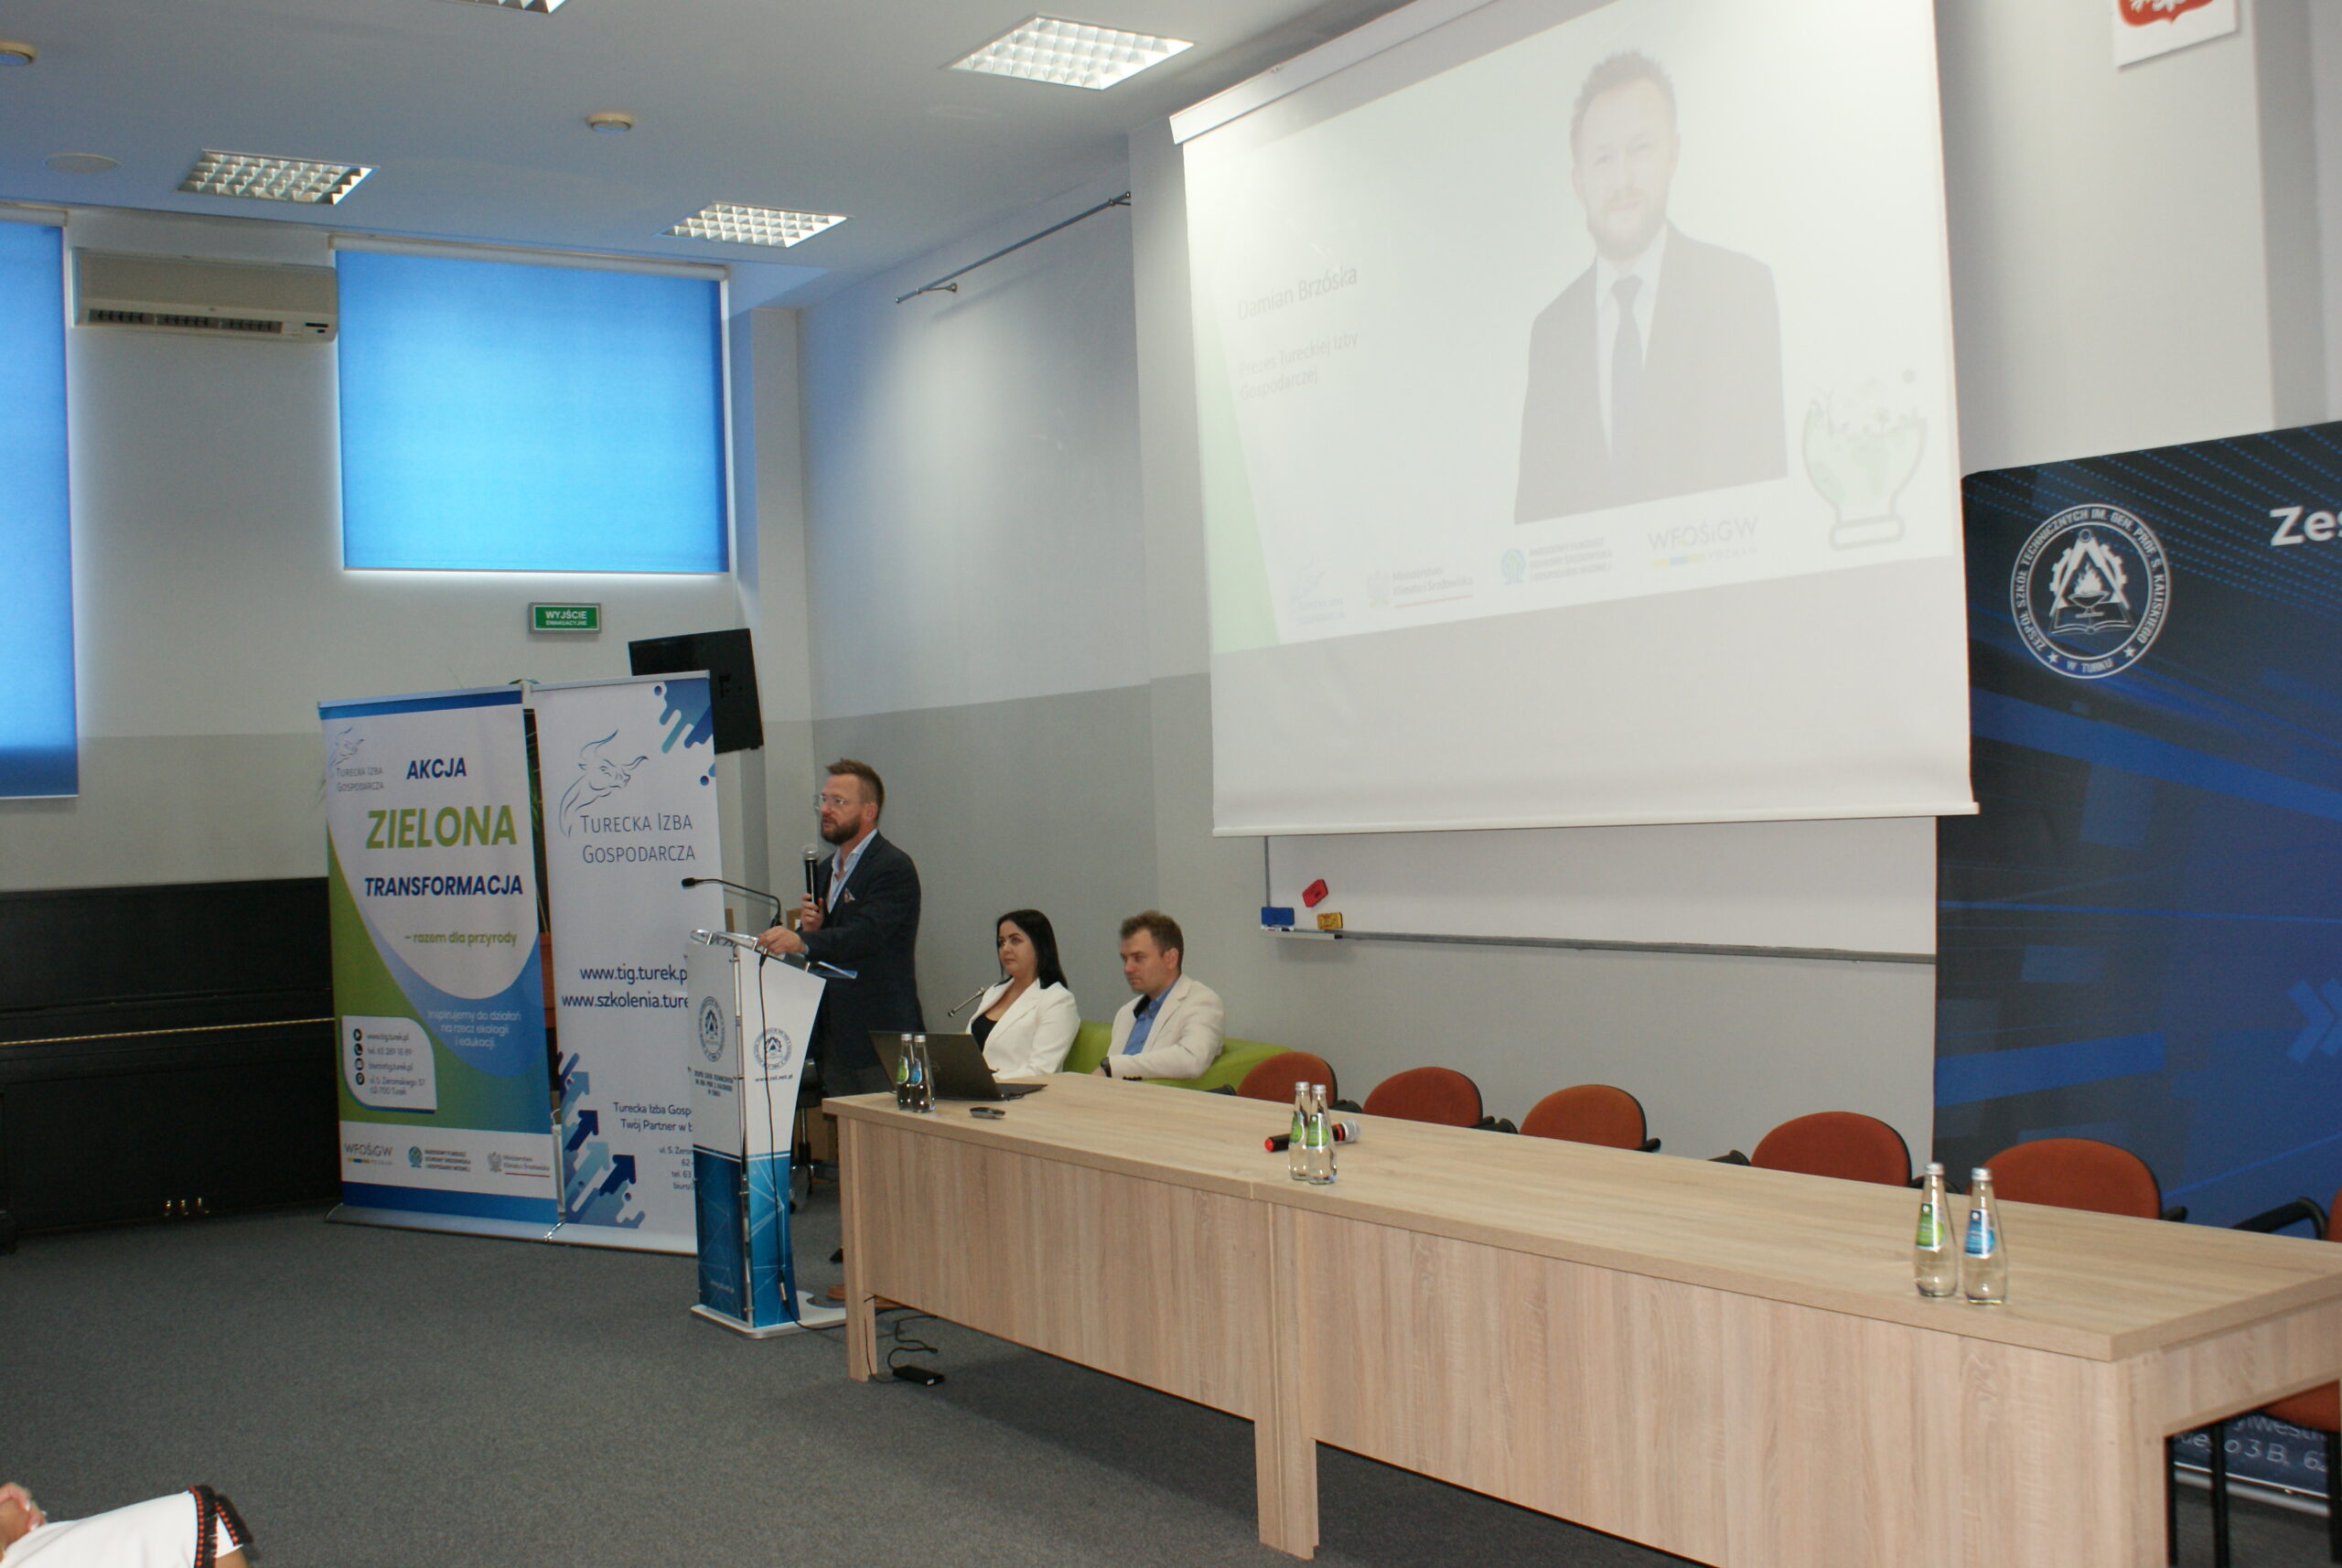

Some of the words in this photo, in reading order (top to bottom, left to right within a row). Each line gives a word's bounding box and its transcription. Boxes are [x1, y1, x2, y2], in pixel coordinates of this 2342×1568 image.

[1238, 289, 1295, 320] Damian
[1297, 264, 1359, 300] Brzóska
[1278, 338, 1331, 365] Tureckiej
[1333, 330, 1359, 350] Izby
[1241, 366, 1318, 401] Gospodarczej
[1647, 515, 1759, 551] WFOŚiGW
[2019, 509, 2090, 566] TECHNICZNYCH
[2090, 508, 2108, 521] IM.
[2109, 511, 2134, 532] GEN.
[2133, 528, 2156, 558] PROF.
[2269, 506, 2342, 547] Ze
[545, 609, 587, 619] WYJŚCIE
[2066, 660, 2079, 671] W
[2080, 658, 2114, 674] TURKU
[406, 757, 467, 780] AKCJA
[366, 805, 518, 849] ZIELONA
[580, 814, 652, 833] TURECKA
[658, 811, 693, 831] IZBA
[583, 844, 696, 864] GOSPODARCZA
[365, 875, 523, 897] TRANSFORMACJA
[413, 933, 446, 944] razem
[448, 931, 466, 943] dla
[467, 931, 518, 948] przyrody
[477, 1010, 489, 1021] do
[440, 1025, 452, 1033] na
[613, 1101, 648, 1113] Turecka
[649, 1103, 666, 1114] Izba
[620, 1117, 641, 1133] Twój
[642, 1119, 677, 1131] Partner
